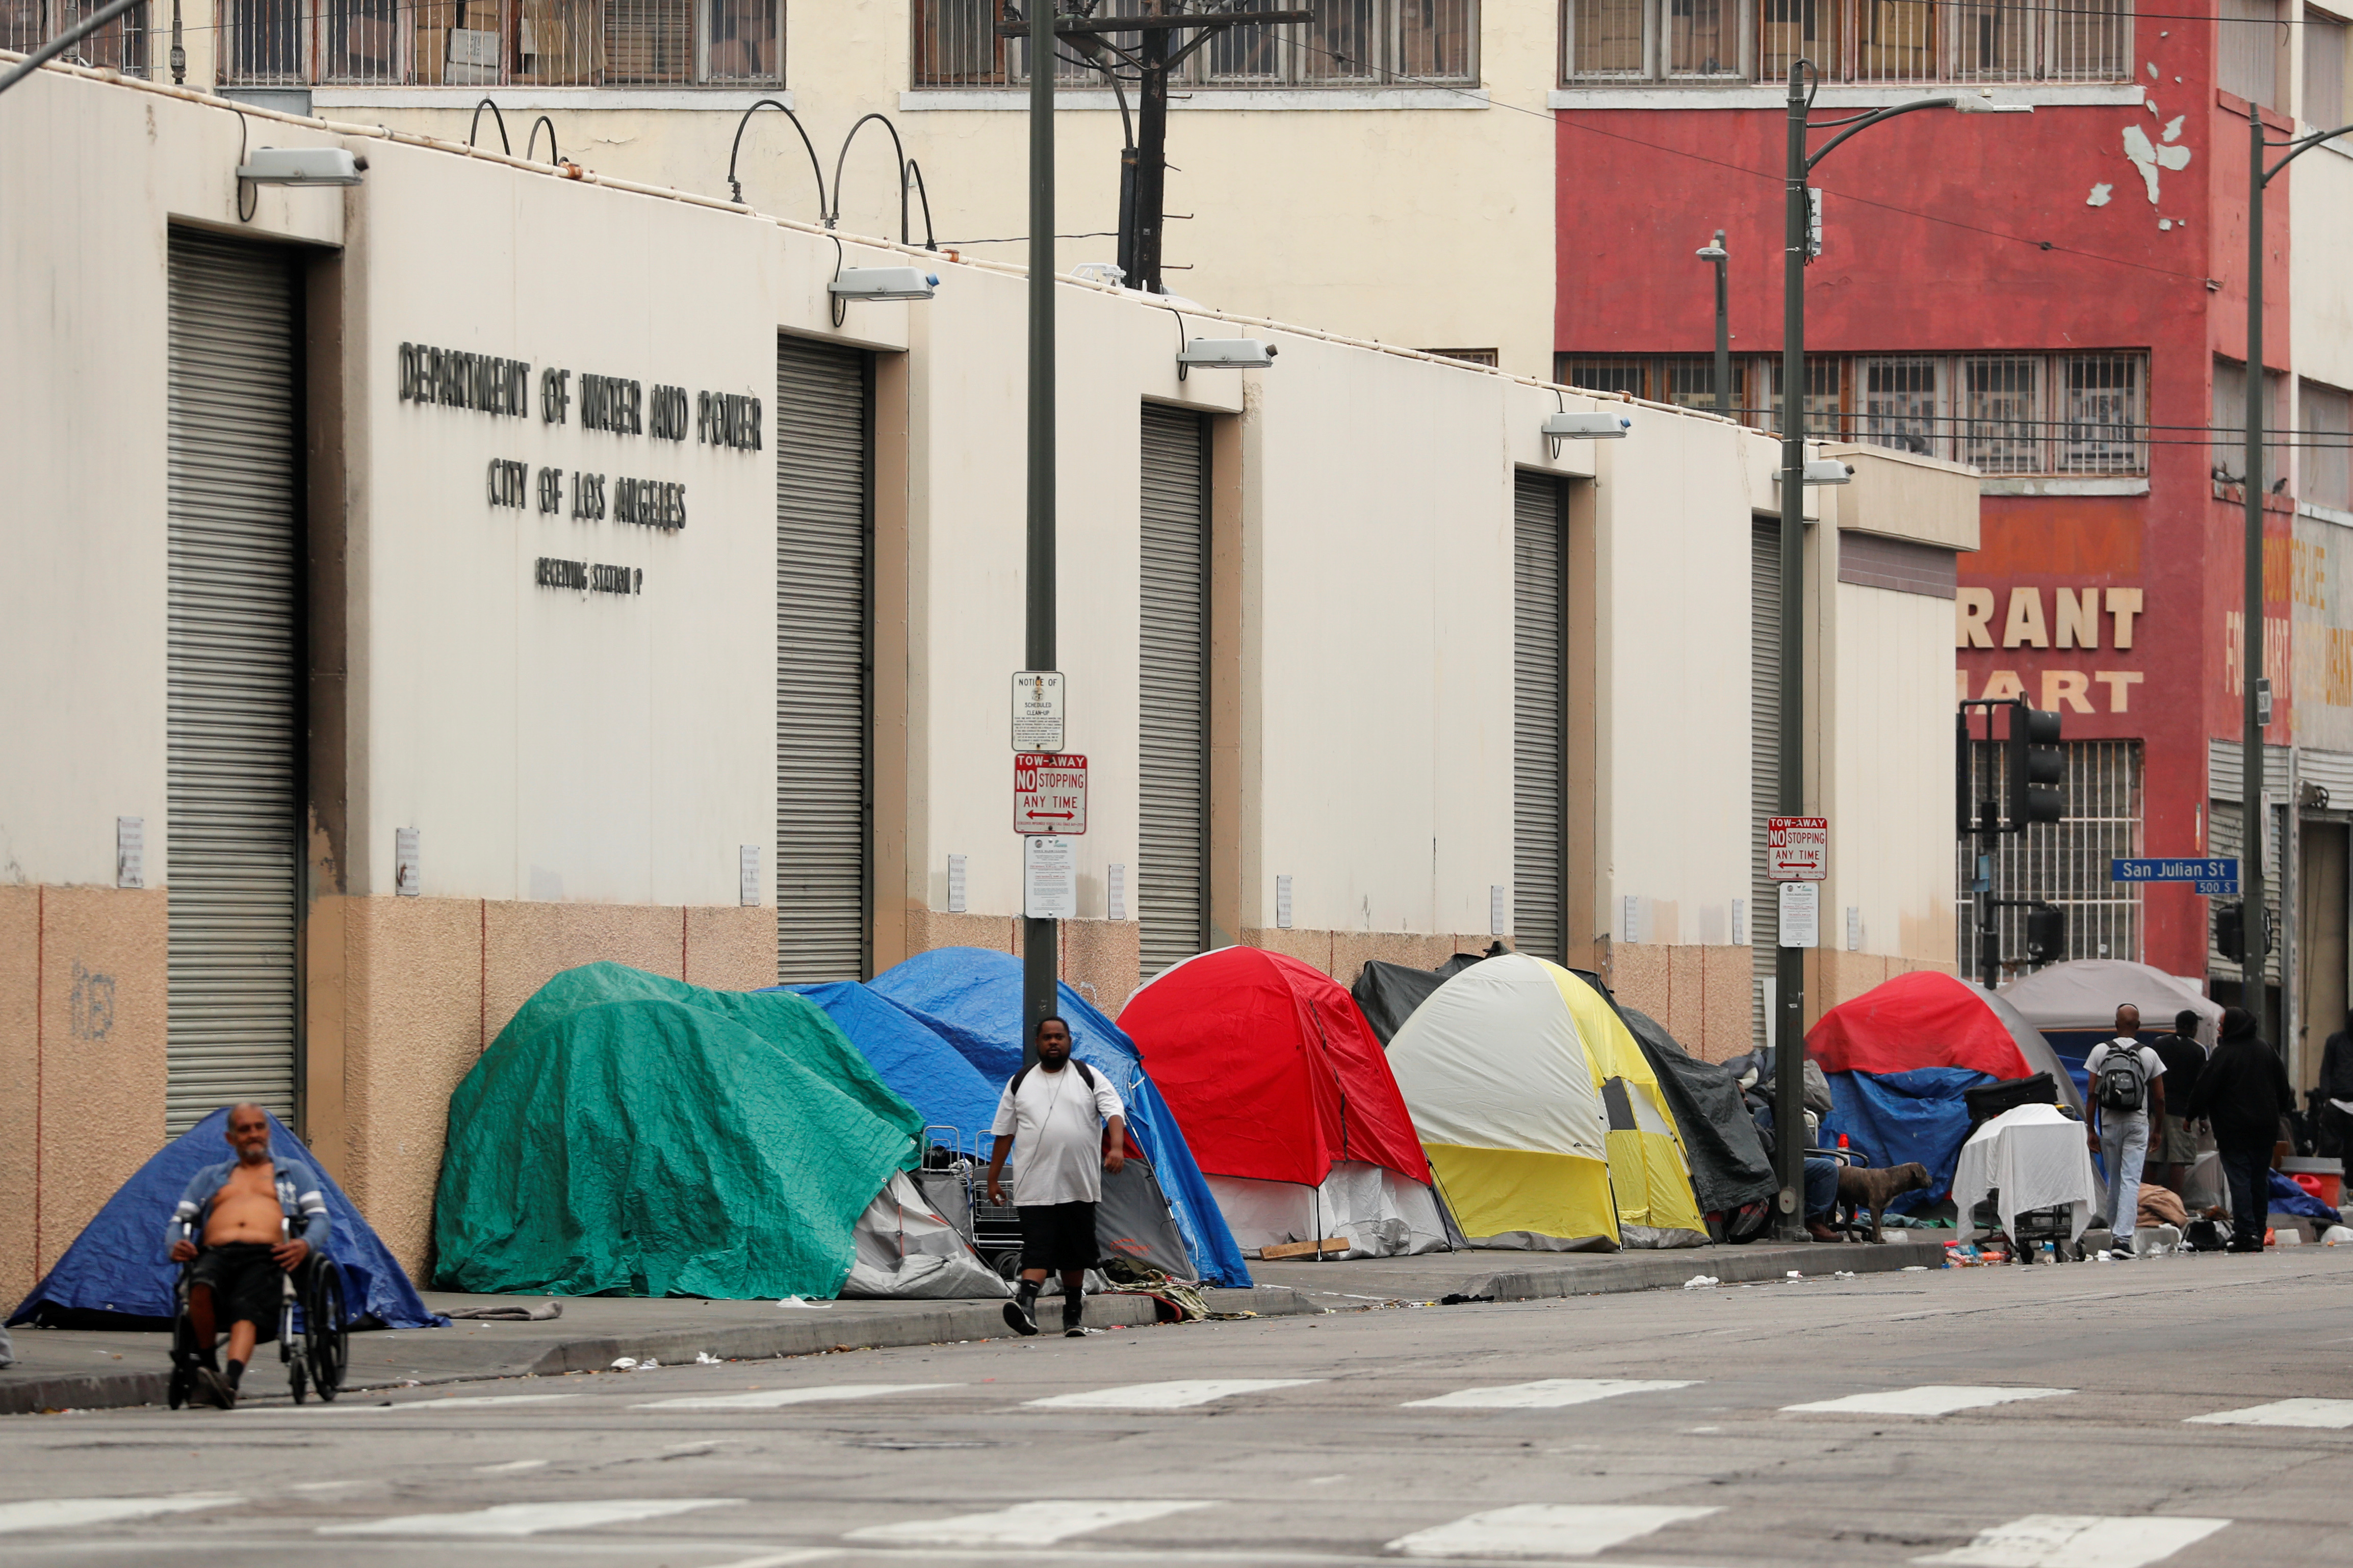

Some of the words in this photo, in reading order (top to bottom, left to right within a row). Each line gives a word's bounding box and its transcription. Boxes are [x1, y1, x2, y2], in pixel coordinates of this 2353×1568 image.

[400, 342, 531, 419] DEPARTMENT
[542, 367, 570, 424] OF
[581, 373, 642, 435] WATER
[652, 384, 688, 441] AND
[699, 390, 762, 451] POWER
[488, 458, 528, 509] CITY
[538, 466, 562, 515] OF
[573, 471, 605, 520] LOS
[614, 477, 686, 529] ANGELES
[536, 557, 587, 590] RECEIVING
[591, 563, 631, 594] STATION
[1956, 587, 2143, 648] RANT
[1019, 678, 1044, 686] NOTICE
[1017, 755, 1084, 767] TOW-AWAY
[1017, 770, 1036, 790] NO
[1039, 773, 1084, 789] STOPPING
[1023, 795, 1046, 807] ANY
[1052, 796, 1078, 808] TIME
[1770, 818, 1825, 827] TOW-AWAY
[1770, 830, 1785, 846] NO
[1788, 832, 1825, 844] STOPPING
[1775, 850, 1794, 859] ANY
[1799, 850, 1820, 860] TIME
[2123, 862, 2152, 877] San
[2157, 862, 2202, 877] Julian
[2208, 861, 2225, 876] St
[2200, 882, 2219, 892] 500
[2225, 882, 2231, 892] S
